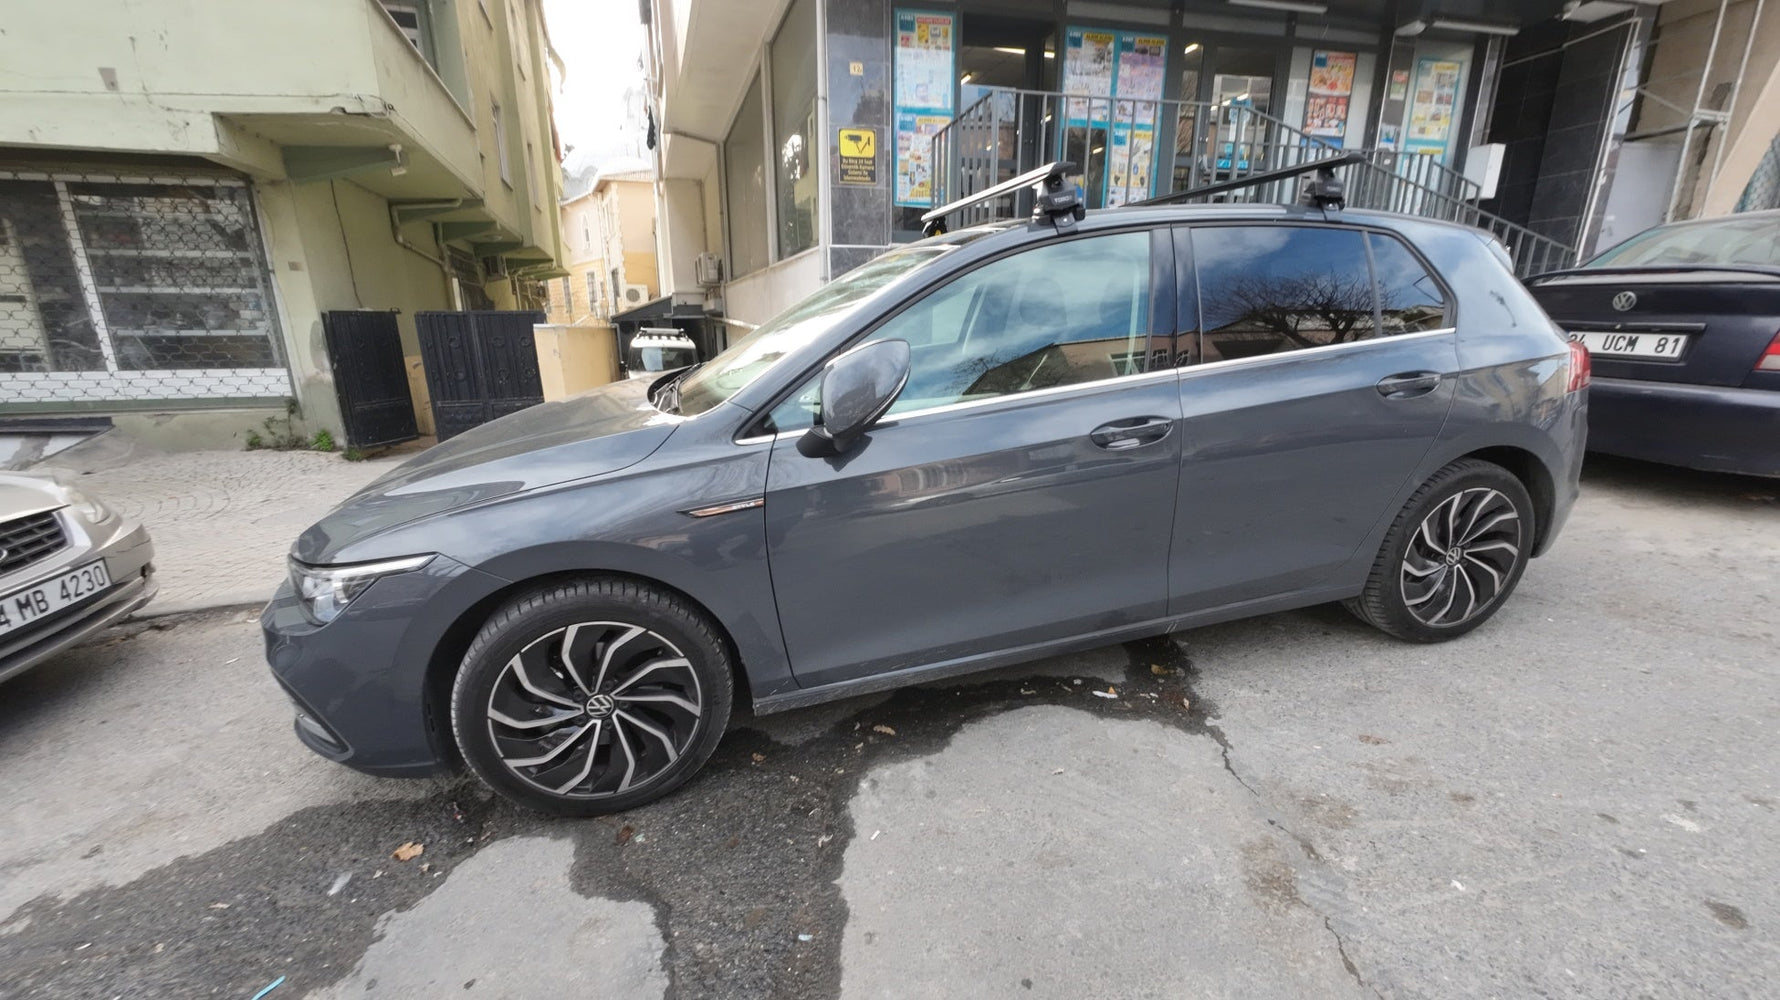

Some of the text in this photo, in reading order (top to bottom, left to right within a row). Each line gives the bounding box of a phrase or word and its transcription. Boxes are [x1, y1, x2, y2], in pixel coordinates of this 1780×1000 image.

[1602, 334, 1639, 352] UCM
[1655, 337, 1680, 354] 81
[15, 589, 49, 621] MB
[60, 565, 105, 601] 4230
